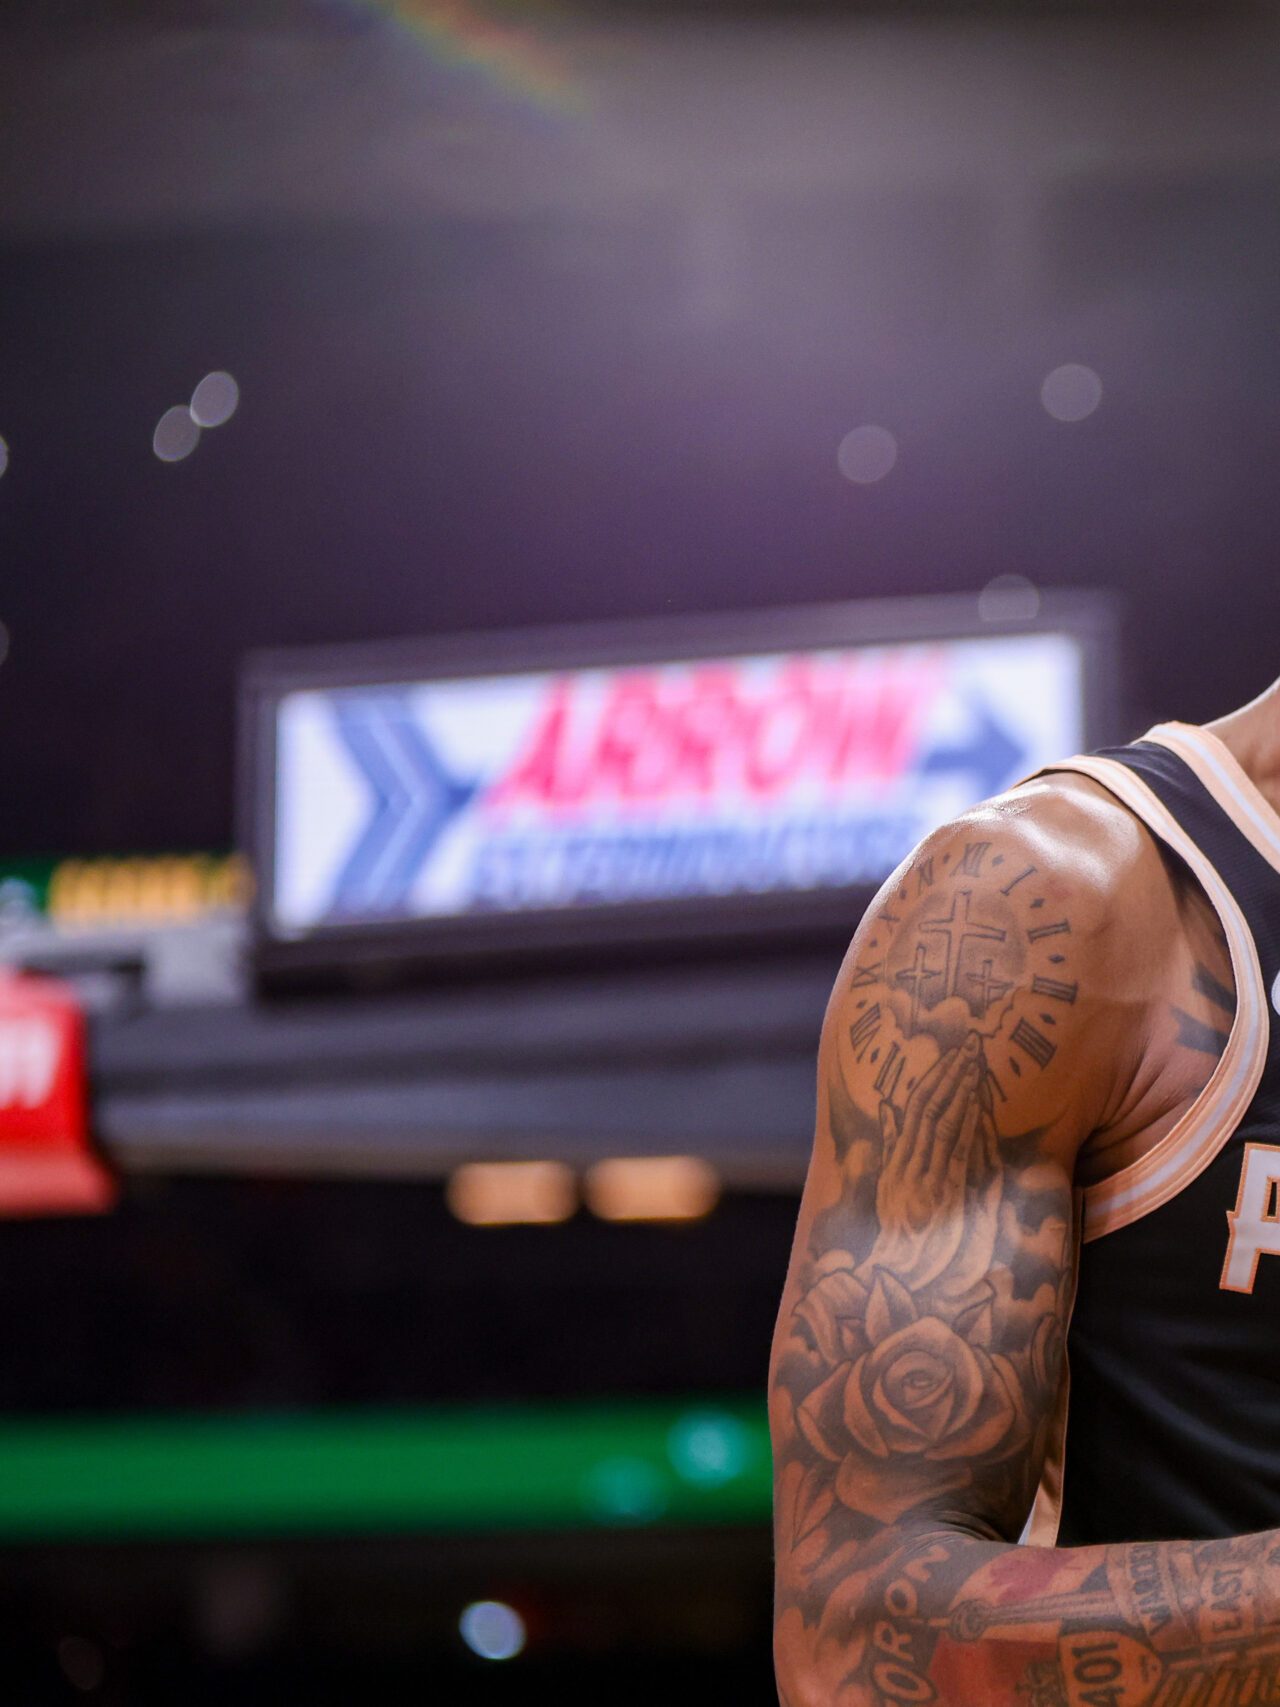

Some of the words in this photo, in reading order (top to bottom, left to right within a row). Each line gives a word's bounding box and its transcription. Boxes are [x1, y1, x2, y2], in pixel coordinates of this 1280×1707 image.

[872, 1545, 950, 1706] ORON
[1210, 1569, 1243, 1633] EAST
[1071, 1641, 1125, 1707] 401
